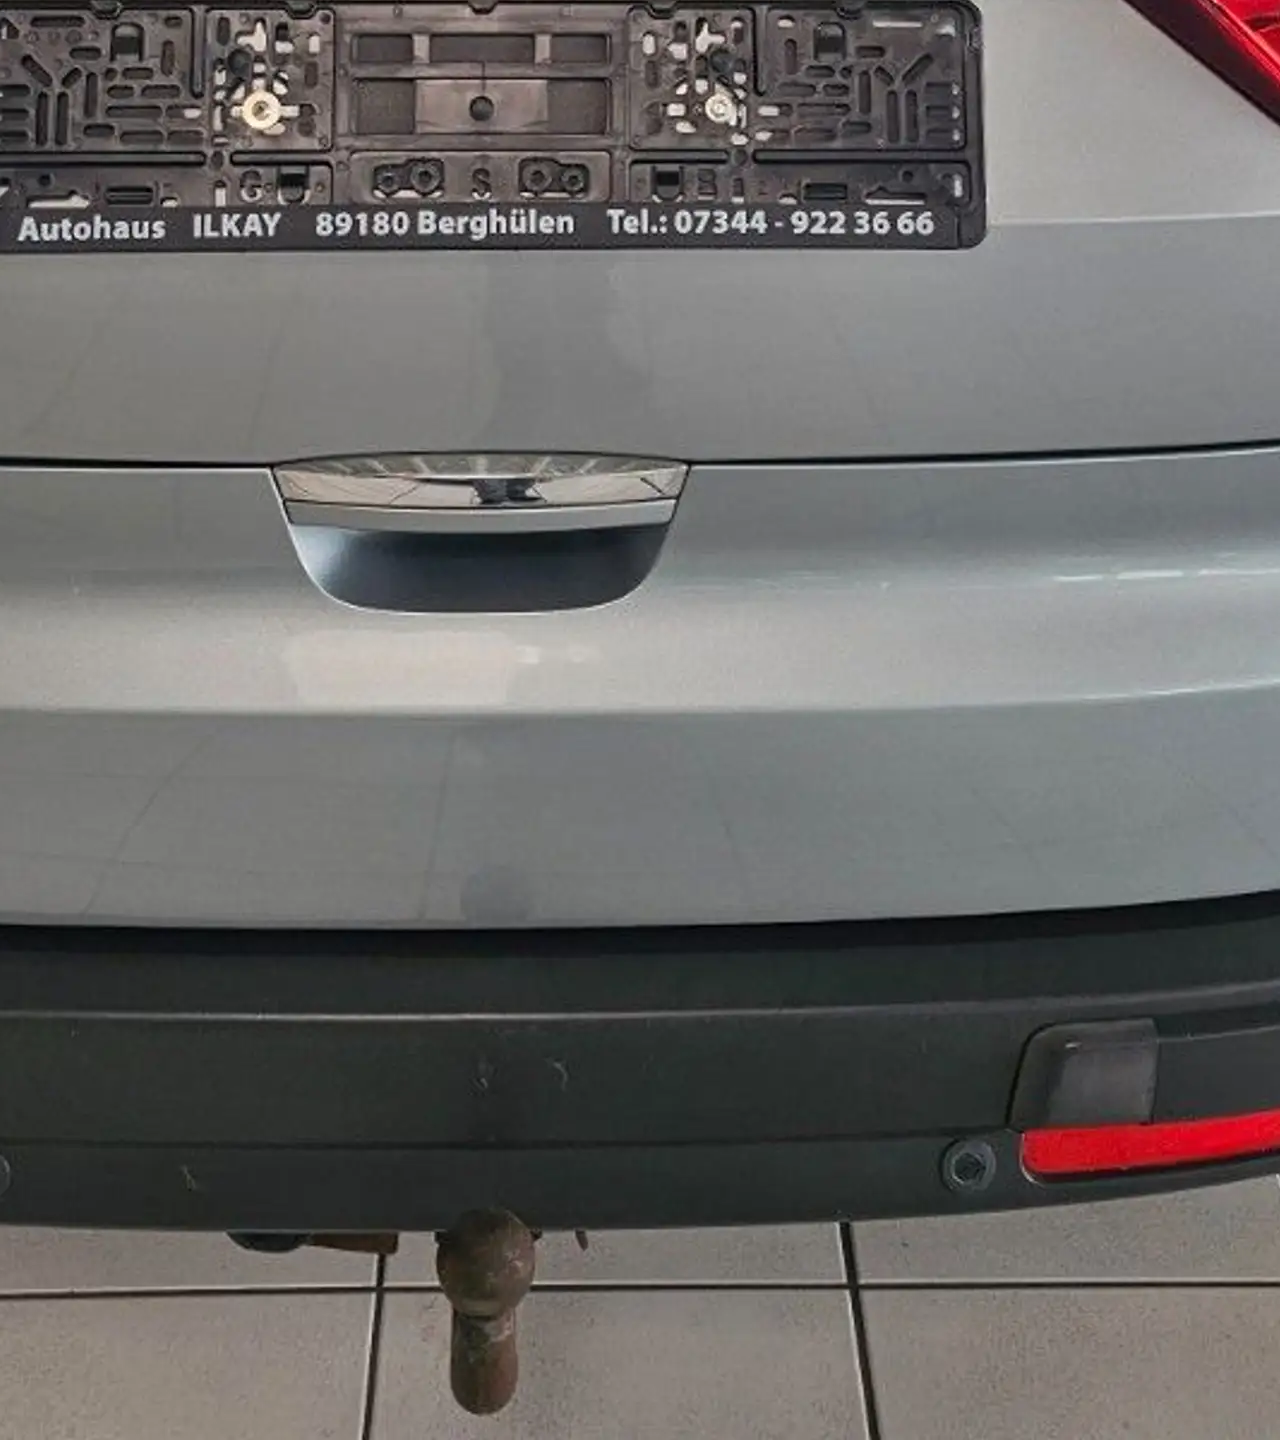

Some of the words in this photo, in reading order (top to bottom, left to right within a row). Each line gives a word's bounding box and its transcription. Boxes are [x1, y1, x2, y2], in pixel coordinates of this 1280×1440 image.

[17, 213, 166, 242] Autohaus
[193, 211, 282, 238] ILKAY
[315, 211, 411, 237] 89180
[417, 207, 574, 241] Berghülen
[606, 207, 668, 234] Tel.:
[674, 209, 768, 234] 07344
[790, 210, 846, 235] 922
[853, 210, 891, 235] 36
[896, 211, 935, 236] 66
